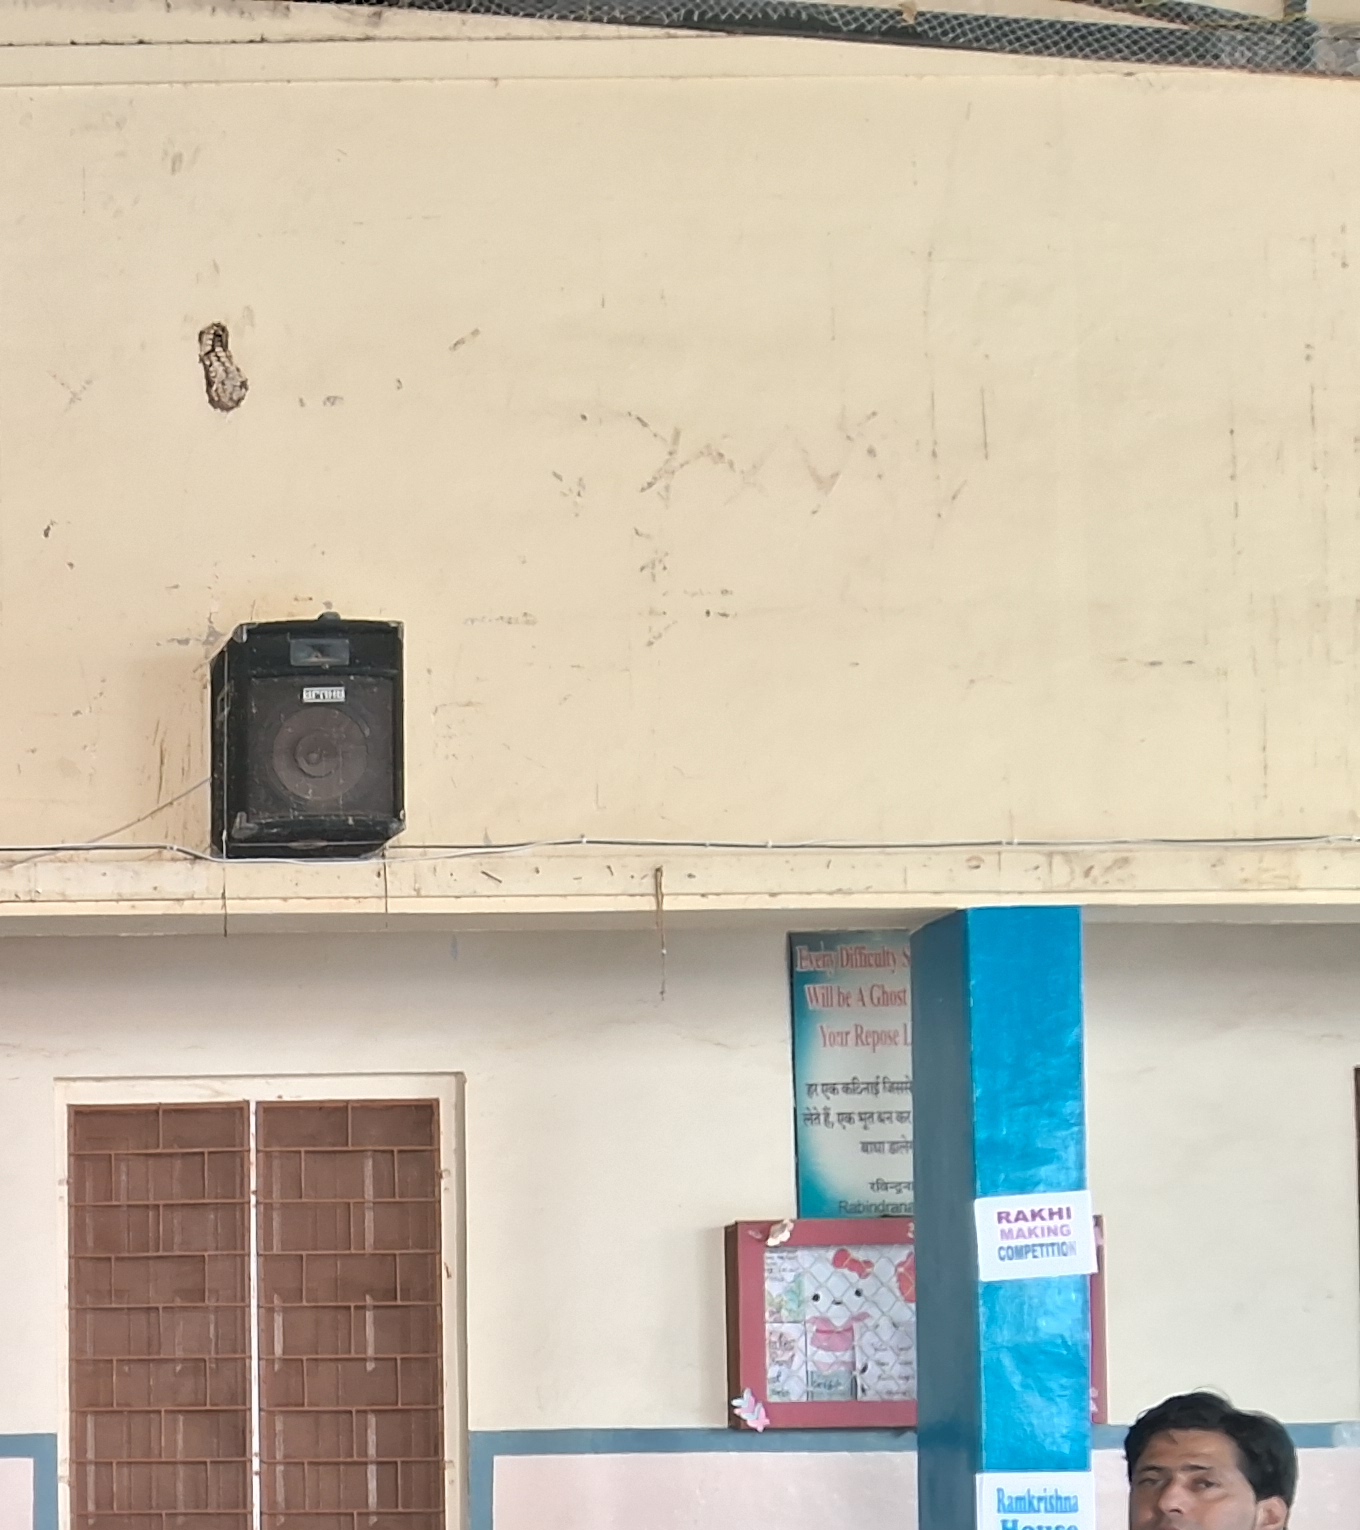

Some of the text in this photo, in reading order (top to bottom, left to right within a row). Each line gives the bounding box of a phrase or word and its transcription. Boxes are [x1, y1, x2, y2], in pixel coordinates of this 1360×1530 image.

[839, 946, 897, 974] Difficulty
[806, 983, 908, 1008] Will be A Ghost
[819, 1024, 851, 1048] Your
[854, 1023, 900, 1053] Repose
[996, 1206, 1072, 1225] RAKHI
[999, 1224, 1072, 1242] MAKING
[997, 1241, 1077, 1262] COMPETITION
[996, 1487, 1079, 1515] Ramkrishna
